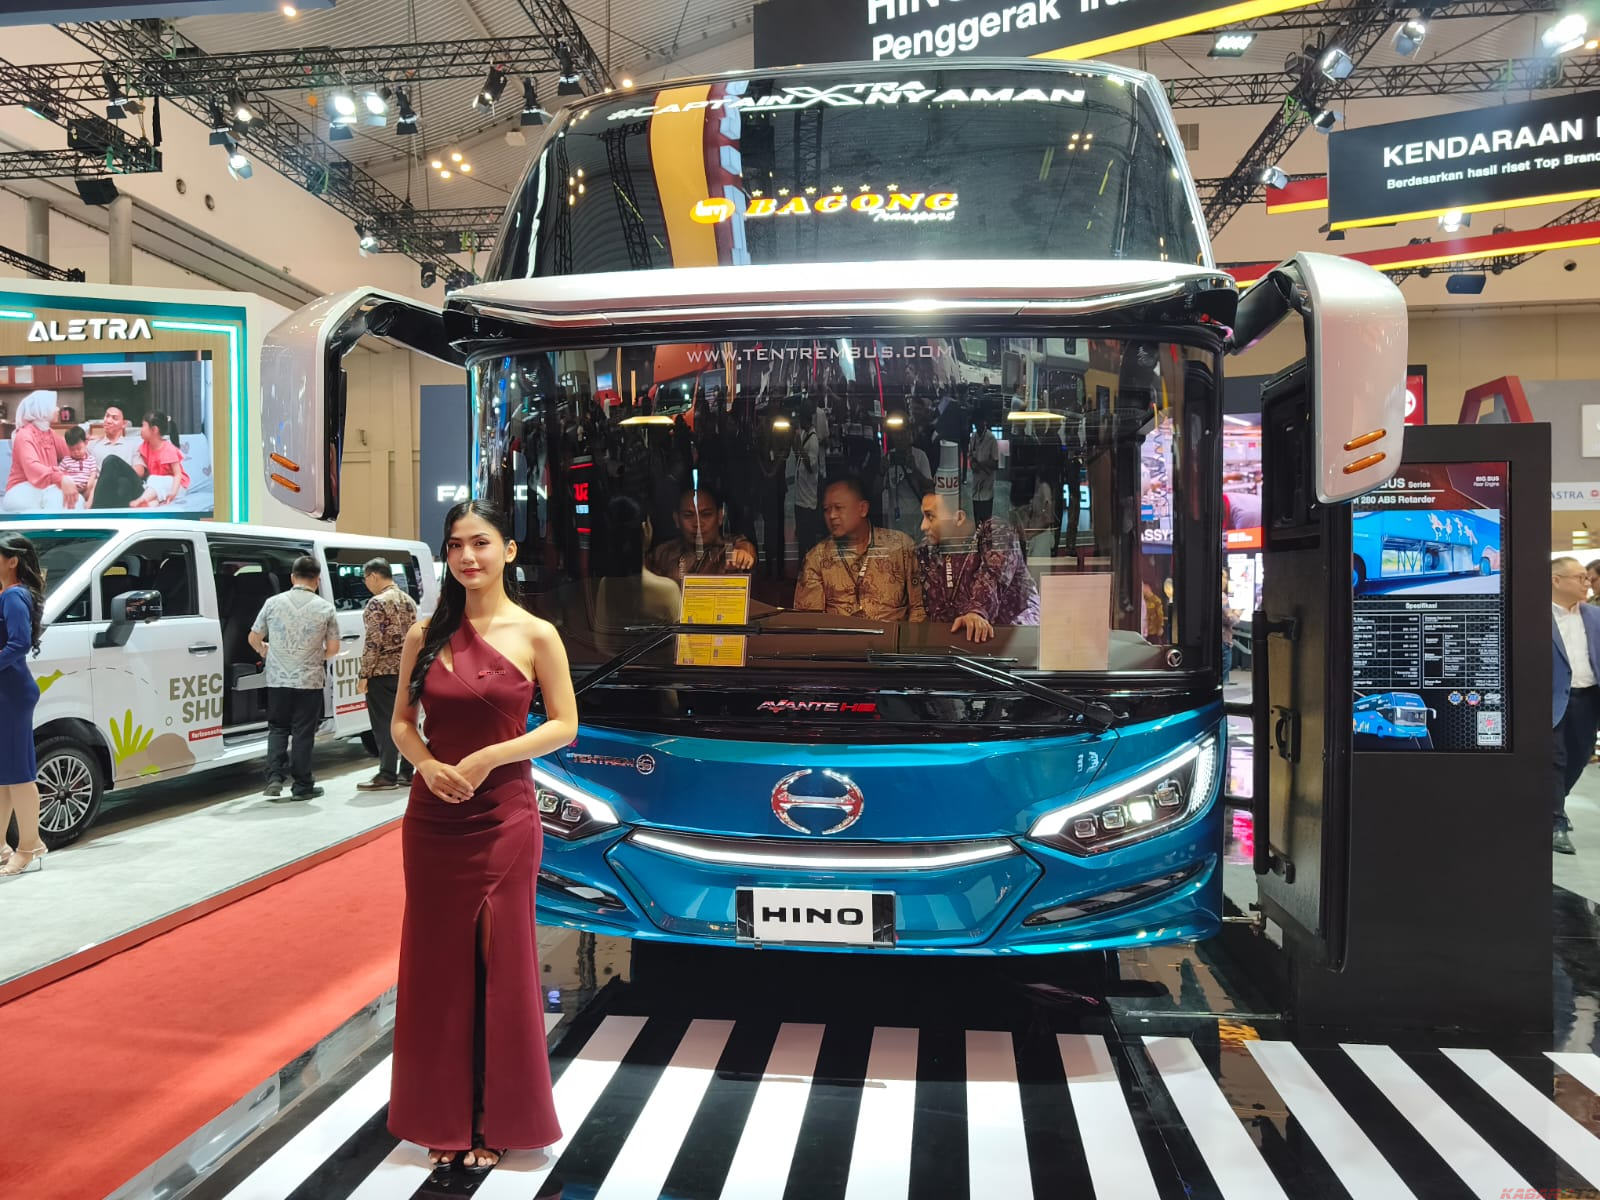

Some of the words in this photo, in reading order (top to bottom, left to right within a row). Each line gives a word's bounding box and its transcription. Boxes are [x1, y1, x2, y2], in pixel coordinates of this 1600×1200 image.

[872, 0, 1061, 61] Penggerak
[863, 89, 1086, 105] NYAMAN
[1383, 118, 1583, 168] KENDARAAN
[1386, 170, 1464, 190] Berdasarkan
[1467, 164, 1498, 179] hasil
[1501, 159, 1531, 174] riset
[1534, 157, 1560, 170] Top
[743, 192, 960, 217] BAGONG
[28, 318, 152, 342] ALETRA
[686, 345, 953, 363] WWW.TENTREMBUS.COM
[1408, 481, 1431, 489] Series
[1378, 495, 1396, 504] ABS
[1398, 495, 1436, 504] Retarder
[169, 672, 223, 701] EXEC
[182, 696, 224, 724] SHU
[762, 906, 864, 926] HINO
